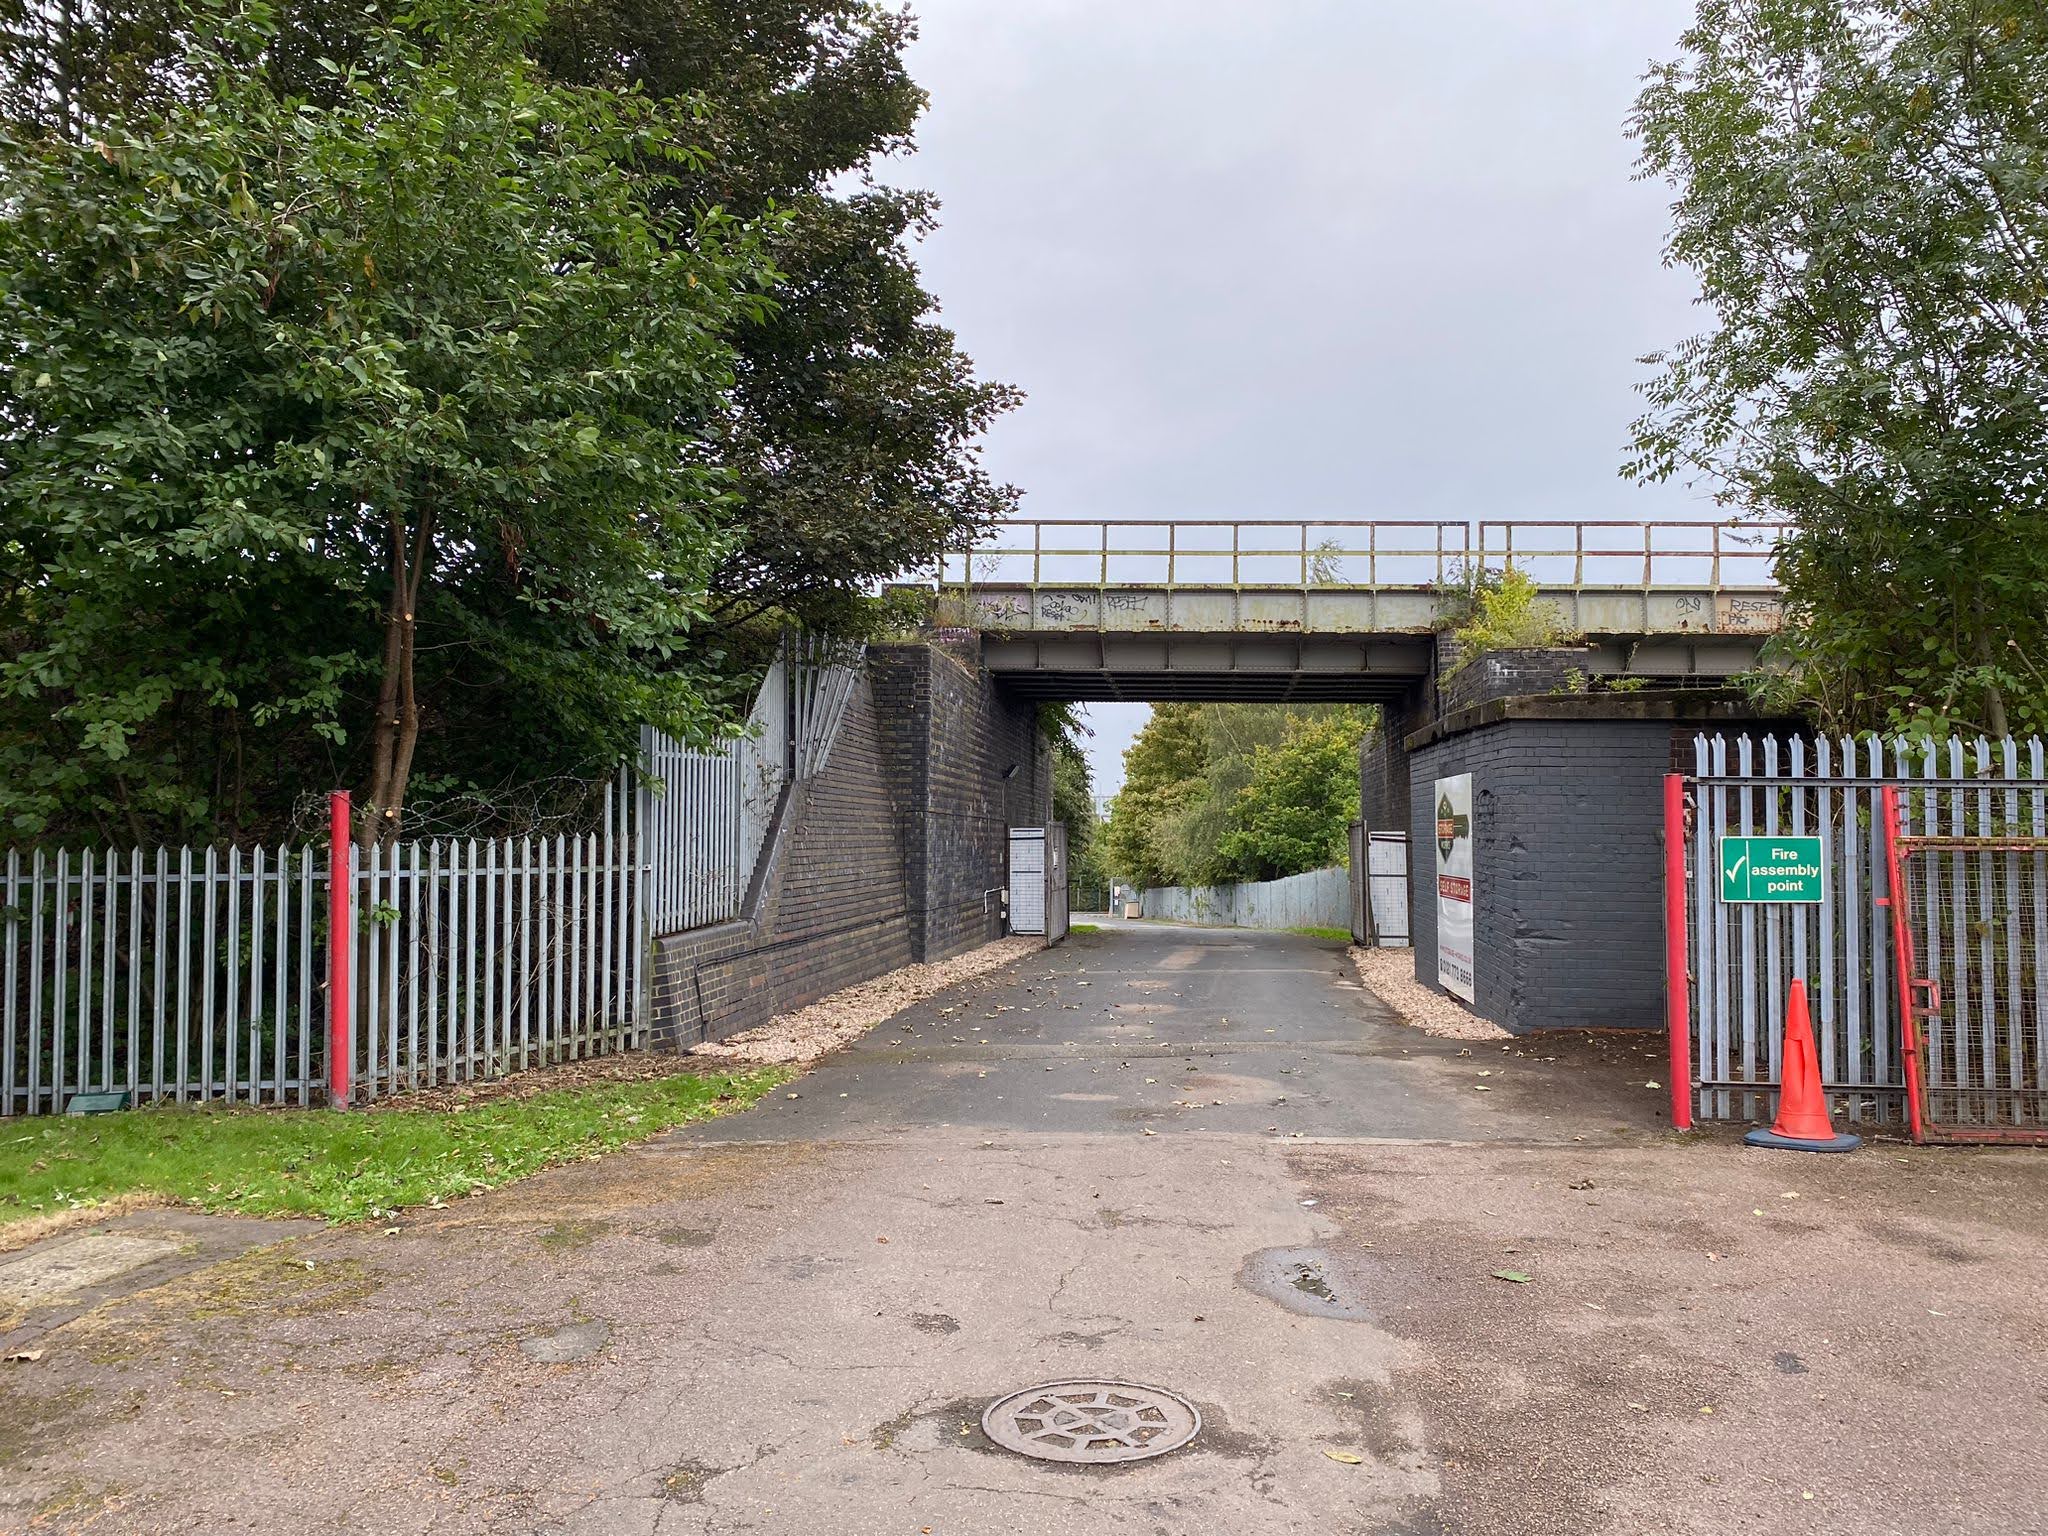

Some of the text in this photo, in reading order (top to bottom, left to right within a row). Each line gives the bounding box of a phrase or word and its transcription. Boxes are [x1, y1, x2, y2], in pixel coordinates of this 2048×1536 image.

[1730, 599, 1777, 612] RESET
[1772, 848, 1798, 860] Fire
[1751, 864, 1819, 878] assembly
[1439, 880, 1469, 897] SELF STORAGE
[1767, 880, 1804, 893] point
